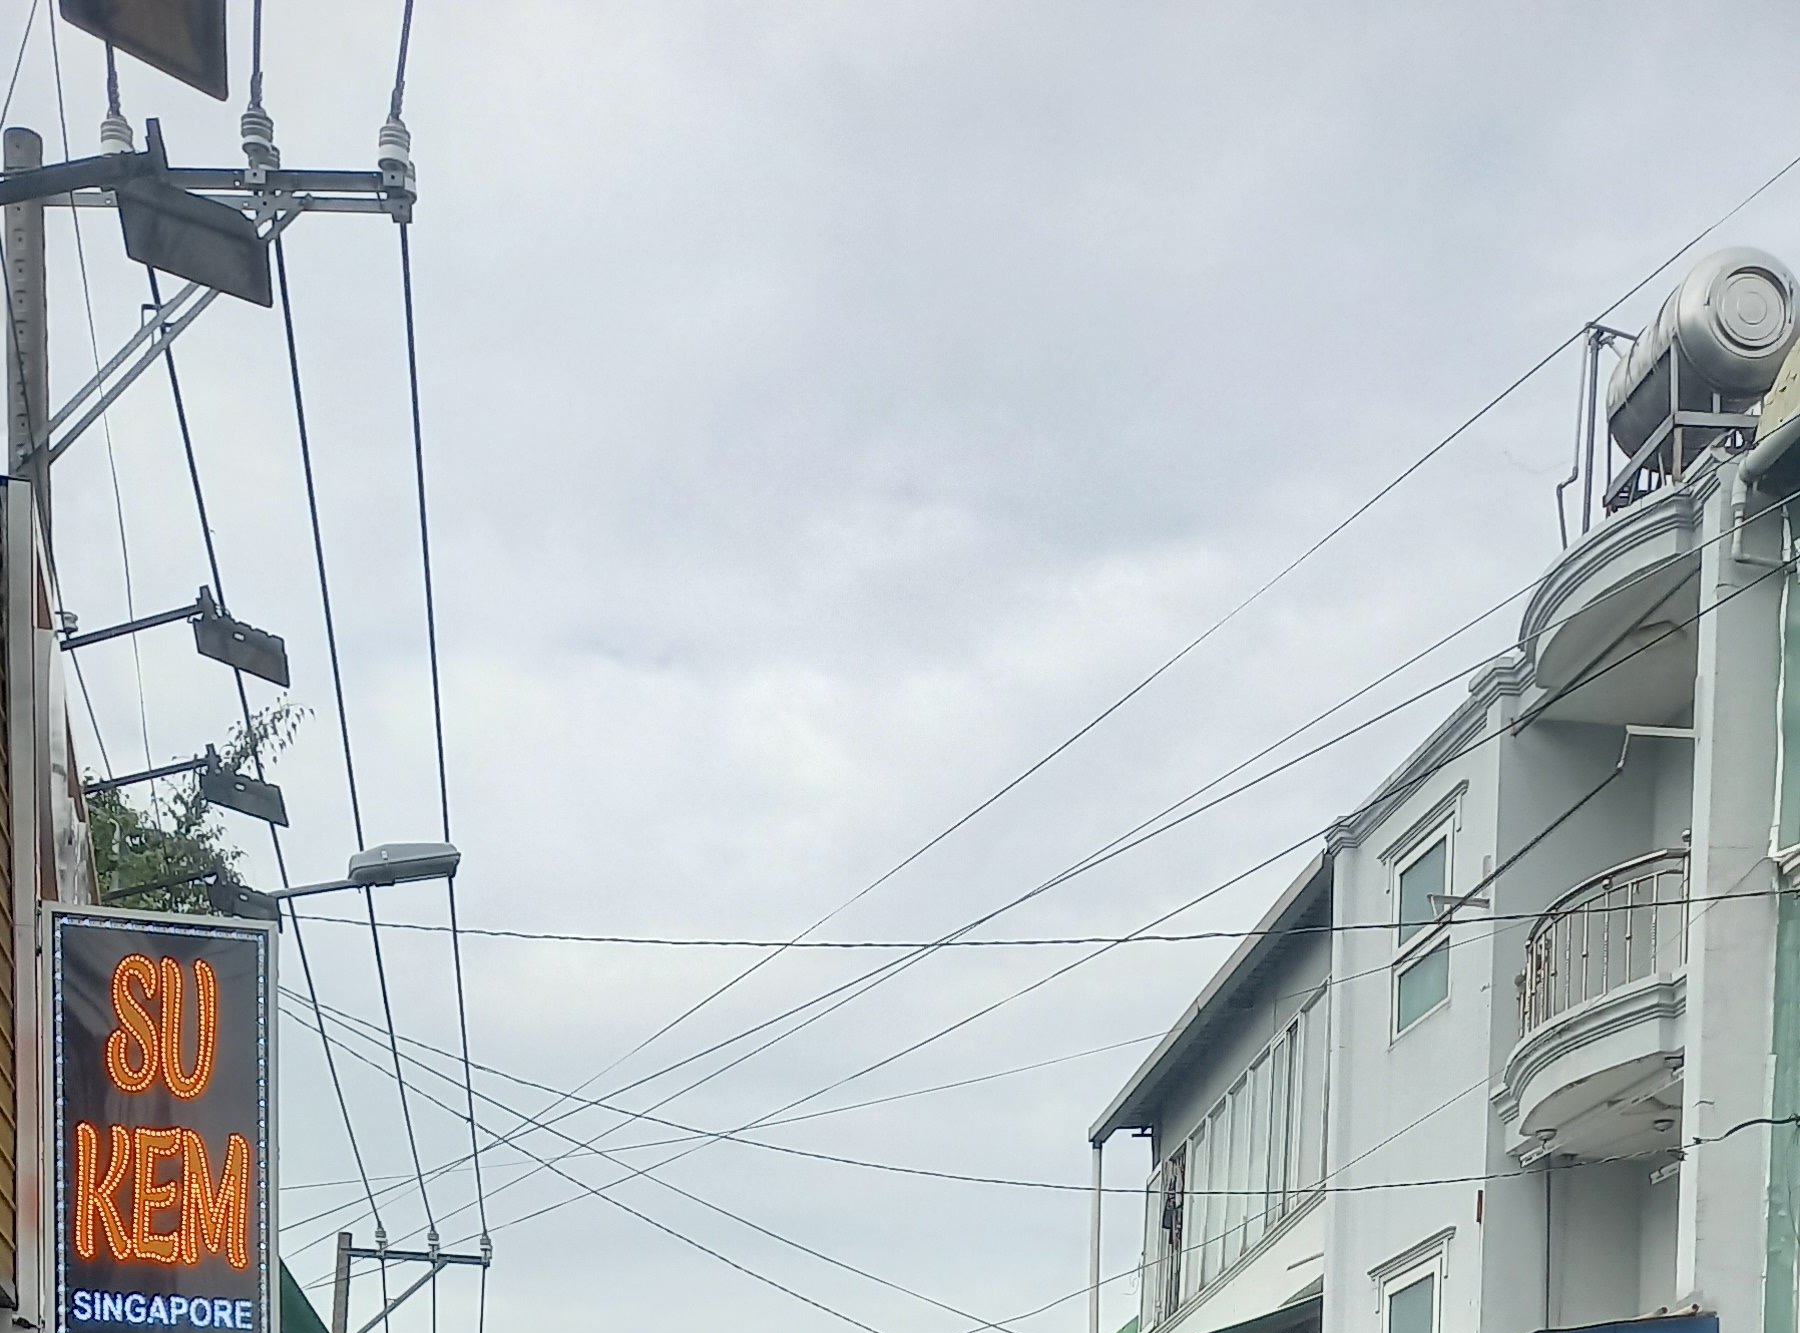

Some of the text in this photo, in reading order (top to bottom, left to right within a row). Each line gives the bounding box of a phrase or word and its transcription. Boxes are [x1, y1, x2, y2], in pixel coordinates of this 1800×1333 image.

[107, 953, 217, 1099] SU
[74, 1121, 249, 1269] KEM
[71, 1288, 255, 1331] SINGAPORE
